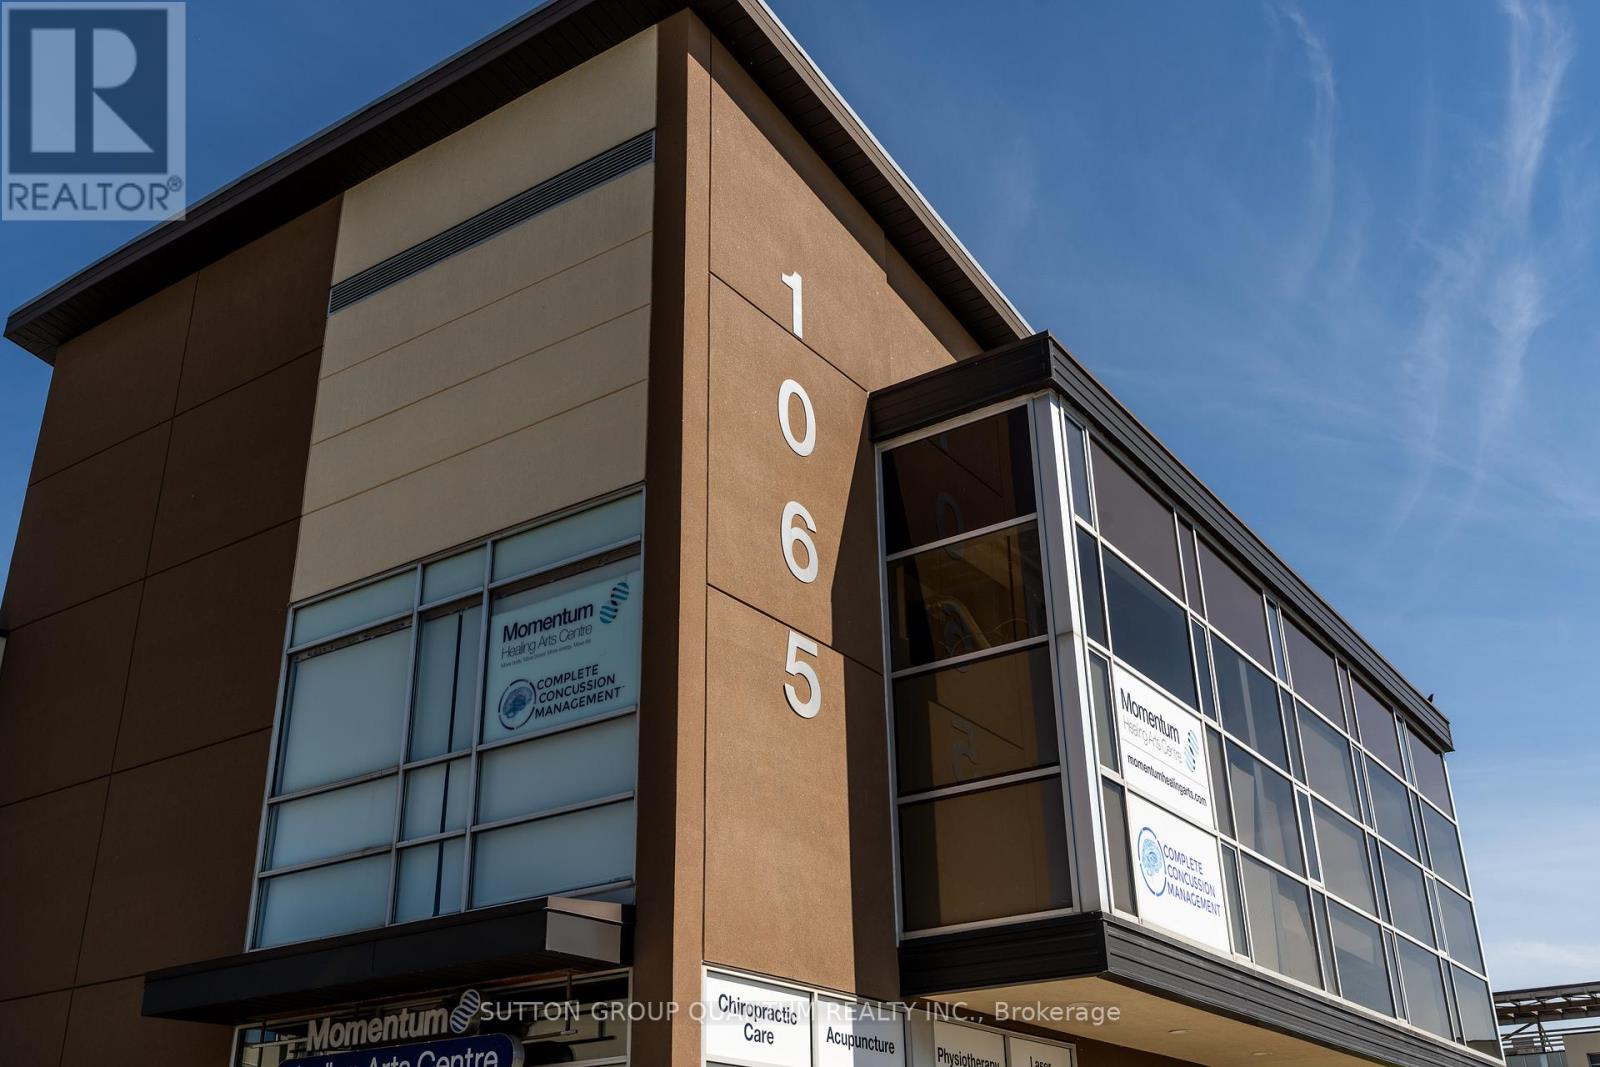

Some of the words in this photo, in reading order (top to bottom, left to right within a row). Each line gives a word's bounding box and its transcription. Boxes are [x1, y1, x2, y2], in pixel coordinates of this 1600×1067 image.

[503, 603, 594, 643] Momentum
[501, 638, 537, 660] Healing
[538, 632, 558, 648] Arts
[559, 623, 593, 643] Centre
[537, 664, 599, 690] COMPLETE
[539, 673, 616, 704] CONCUSSION
[1120, 687, 1180, 744] Momentum
[1127, 754, 1208, 807] momentumhealingarts.com
[1163, 844, 1204, 875] COMPLETE
[1167, 864, 1216, 898] CONCUSSION
[1167, 882, 1221, 917] MANAGEMENT
[718, 993, 798, 1025] Chiropractic
[306, 1007, 449, 1051] Momentum
[743, 1022, 774, 1045] Care
[826, 1026, 896, 1054] Acupuncture
